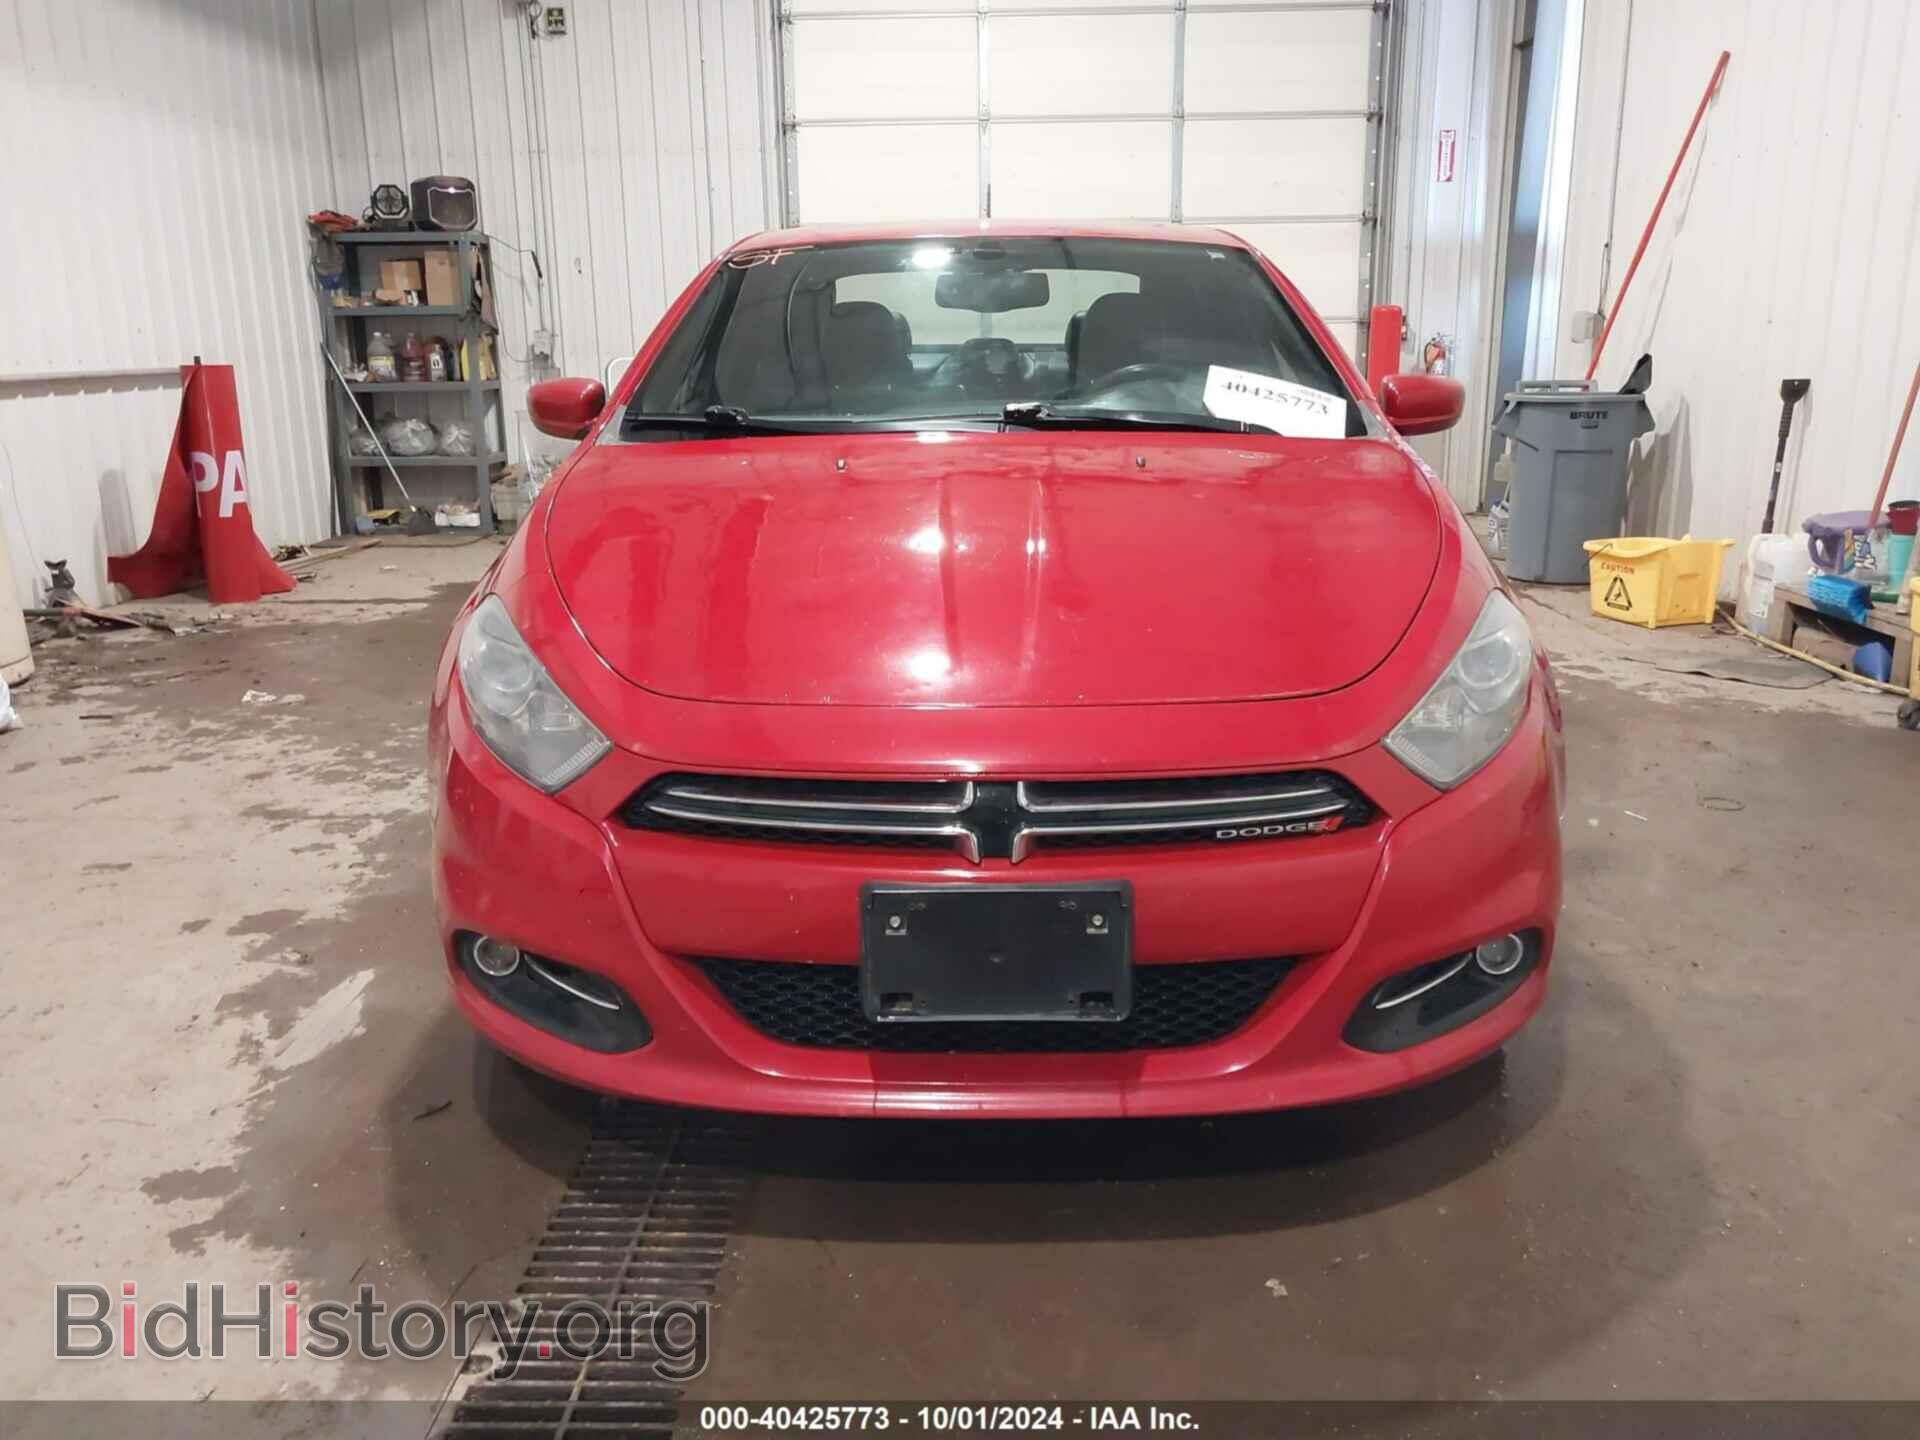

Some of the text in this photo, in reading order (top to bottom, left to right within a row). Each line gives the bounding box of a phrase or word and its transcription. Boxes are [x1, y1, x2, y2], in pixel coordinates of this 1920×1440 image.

[1569, 410, 1608, 420] BRUTE
[1600, 561, 1635, 575] CAUTION
[1216, 821, 1326, 839] DODGE
